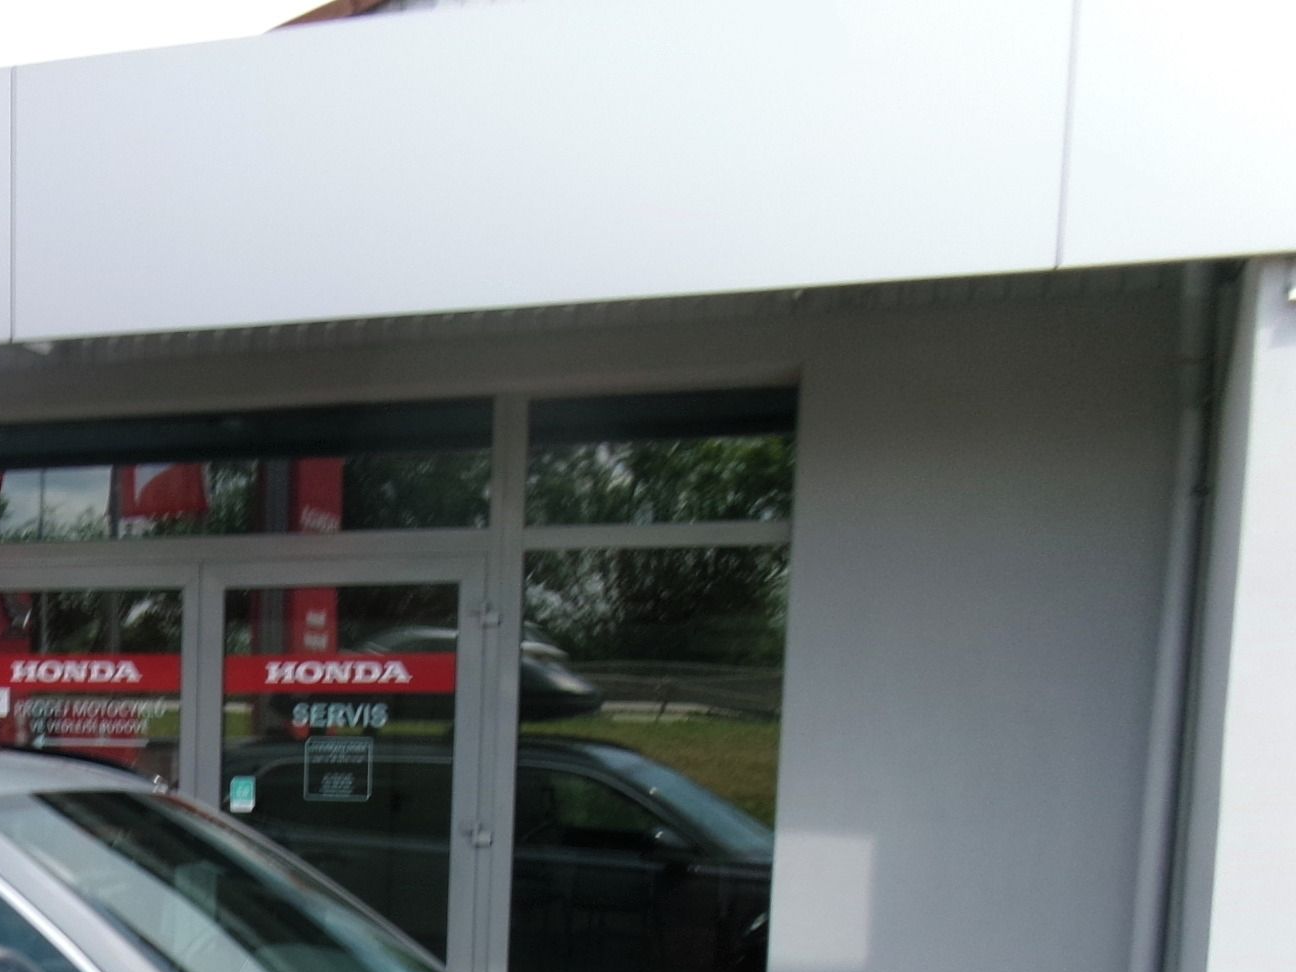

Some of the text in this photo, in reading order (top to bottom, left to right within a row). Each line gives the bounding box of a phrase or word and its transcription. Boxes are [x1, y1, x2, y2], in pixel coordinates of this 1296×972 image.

[11, 660, 142, 684] HONDA
[265, 660, 413, 684] HONDA
[292, 702, 389, 728] SERVIS
